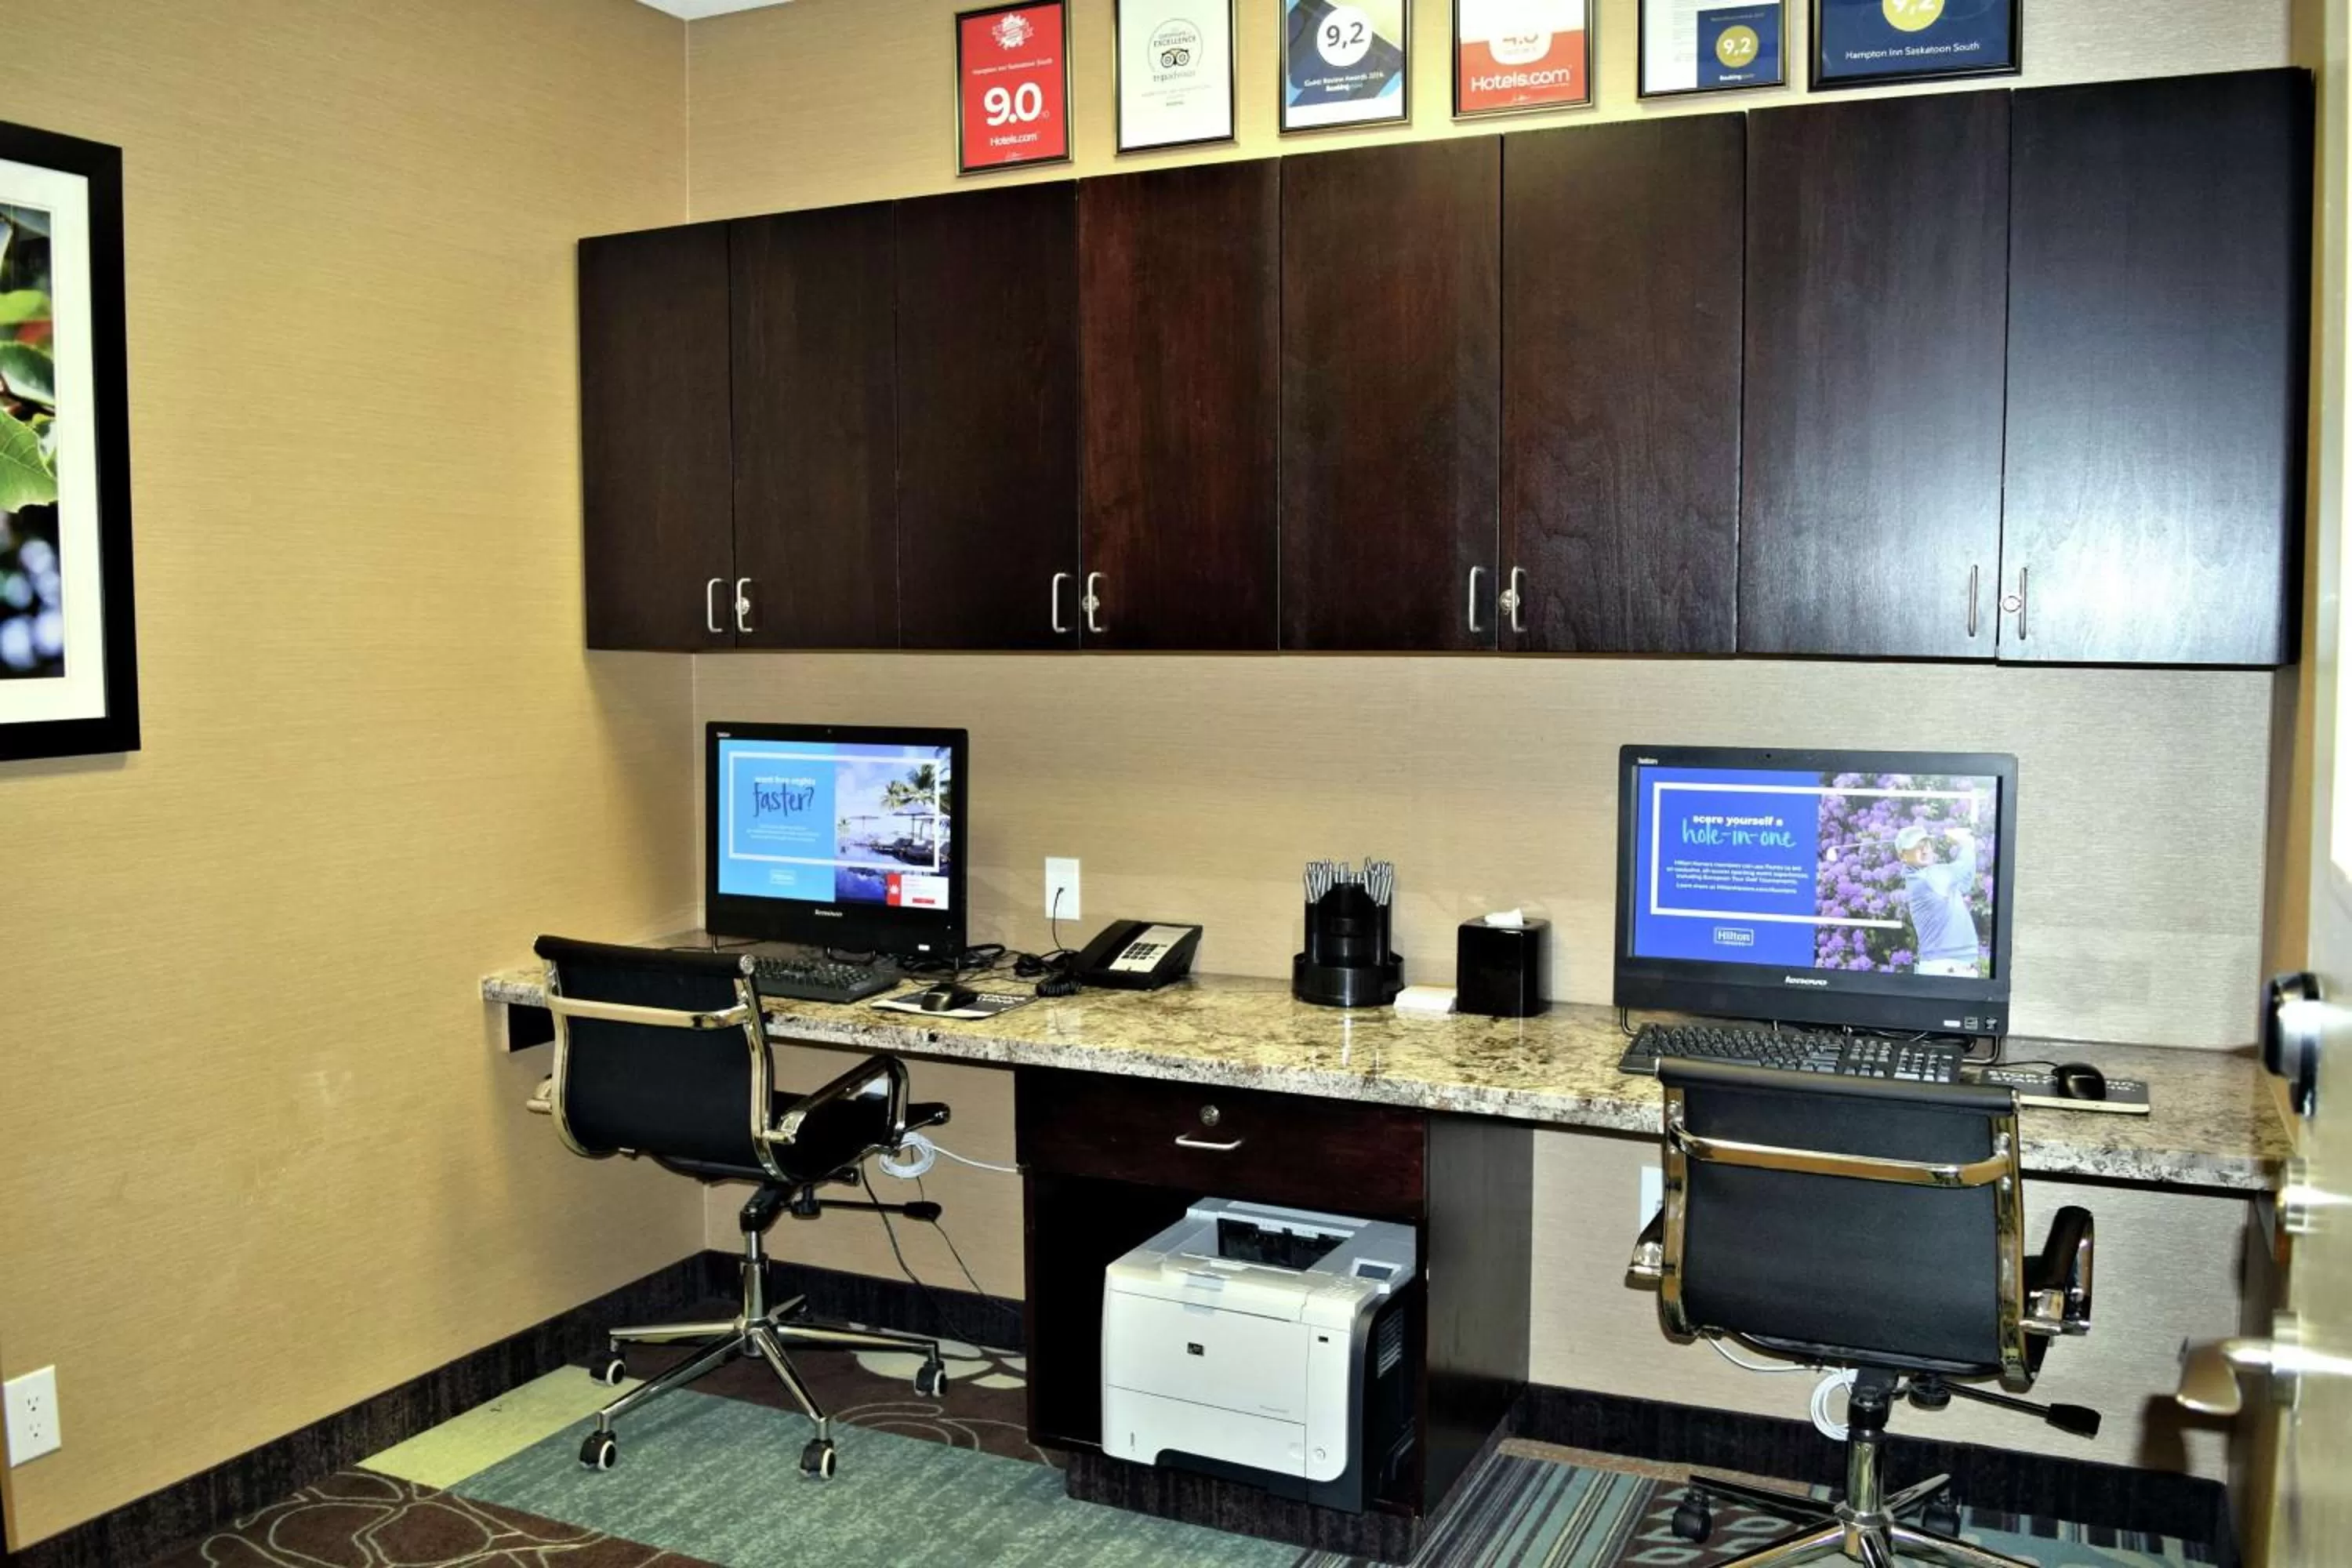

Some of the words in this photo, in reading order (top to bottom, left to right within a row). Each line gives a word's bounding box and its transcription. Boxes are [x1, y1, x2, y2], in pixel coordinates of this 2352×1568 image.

[1327, 22, 1364, 49] 9,2
[1723, 37, 1751, 56] 9,2
[1845, 50, 1887, 60] Hampton
[1905, 45, 1951, 56] Saskatoon
[1953, 42, 1980, 52] South
[1471, 68, 1570, 93] Hotels.com
[984, 82, 1042, 125] 9.0
[753, 782, 815, 818] faster?
[1682, 818, 1798, 848] hole-in-one
[1693, 815, 1724, 824] score
[1726, 815, 1774, 827] yourself
[1718, 931, 1751, 941] Hilton
